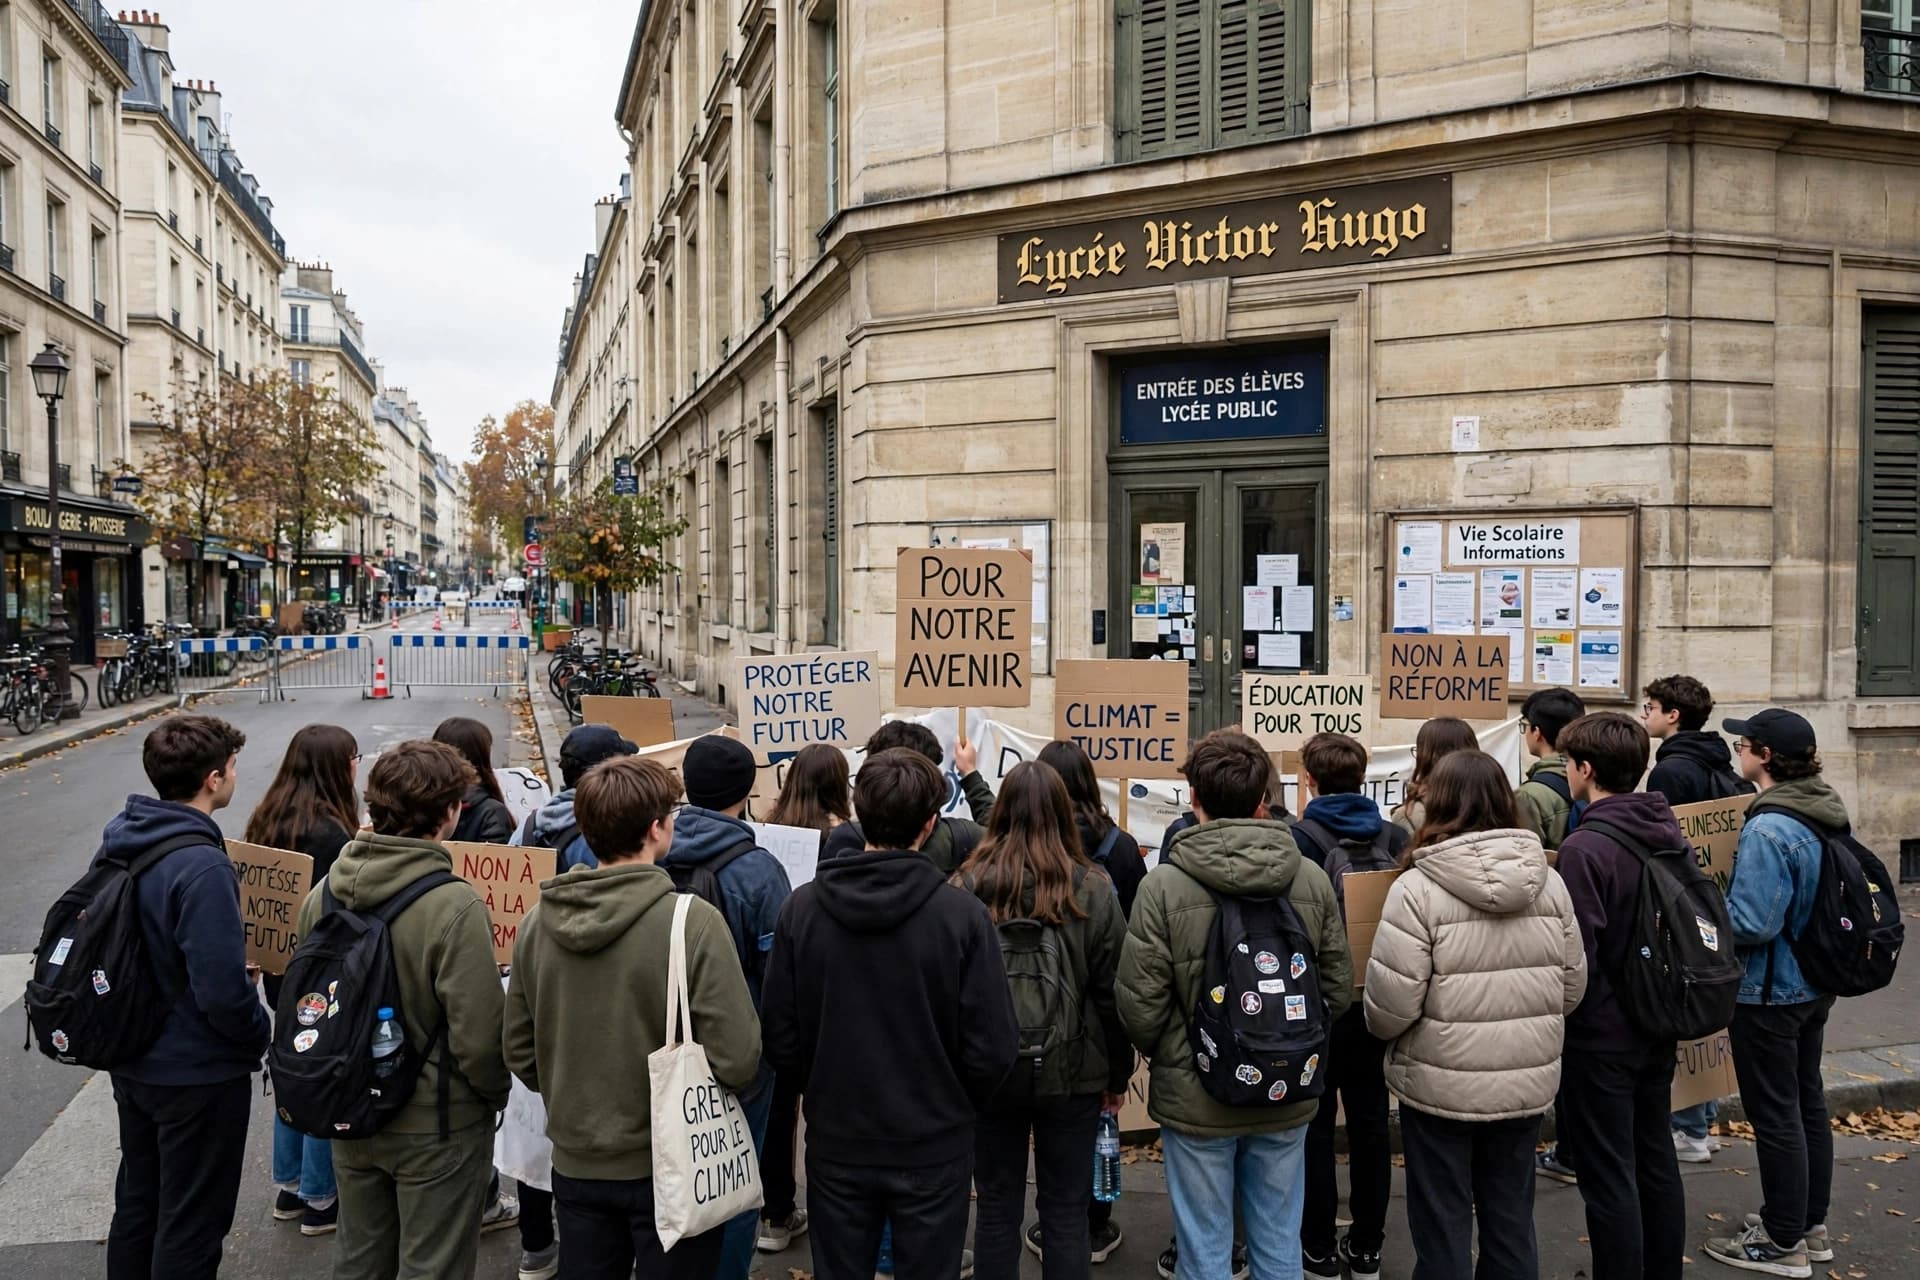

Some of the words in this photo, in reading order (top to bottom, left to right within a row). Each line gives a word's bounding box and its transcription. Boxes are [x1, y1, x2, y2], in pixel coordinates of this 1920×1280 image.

[1016, 232, 1126, 294] Lycée
[1143, 216, 1280, 270] Victor
[1298, 197, 1428, 257] Hugo
[1137, 377, 1197, 400] ENTRÉE
[1203, 377, 1234, 395] DES
[1241, 370, 1304, 392] ÉLÈVES
[1162, 400, 1211, 423] LYCÉE
[1217, 400, 1277, 419] PUBLIC
[25, 505, 82, 531] BOULGERIE
[1459, 525, 1487, 542] Vie
[1492, 525, 1564, 542] Scolaire
[1463, 545, 1565, 560] Informations
[920, 555, 1005, 598] POUR
[910, 607, 1016, 641] NOTRE
[1391, 643, 1442, 668] NON
[1452, 639, 1467, 668] À
[1478, 646, 1504, 668] LA
[744, 656, 871, 690] PROTÉGER
[903, 651, 1022, 689] AVENIR
[1249, 678, 1363, 706] ÉDUCATION
[1388, 669, 1503, 702] RÉFORME
[753, 690, 833, 716] NOTRE
[1066, 703, 1157, 728] CLIMAT
[1254, 712, 1302, 734] POUR
[1310, 713, 1362, 733] TOUS
[1678, 809, 1737, 839] EUNESSE
[463, 853, 510, 882] NON
[520, 853, 533, 884] À
[247, 895, 293, 924] NOTRE
[485, 885, 495, 911] À
[503, 893, 524, 914] LA
[244, 922, 299, 954] FUTUR
[691, 1128, 728, 1162] POUR
[731, 1120, 744, 1148] LE
[694, 1149, 751, 1204] CLIMAT
